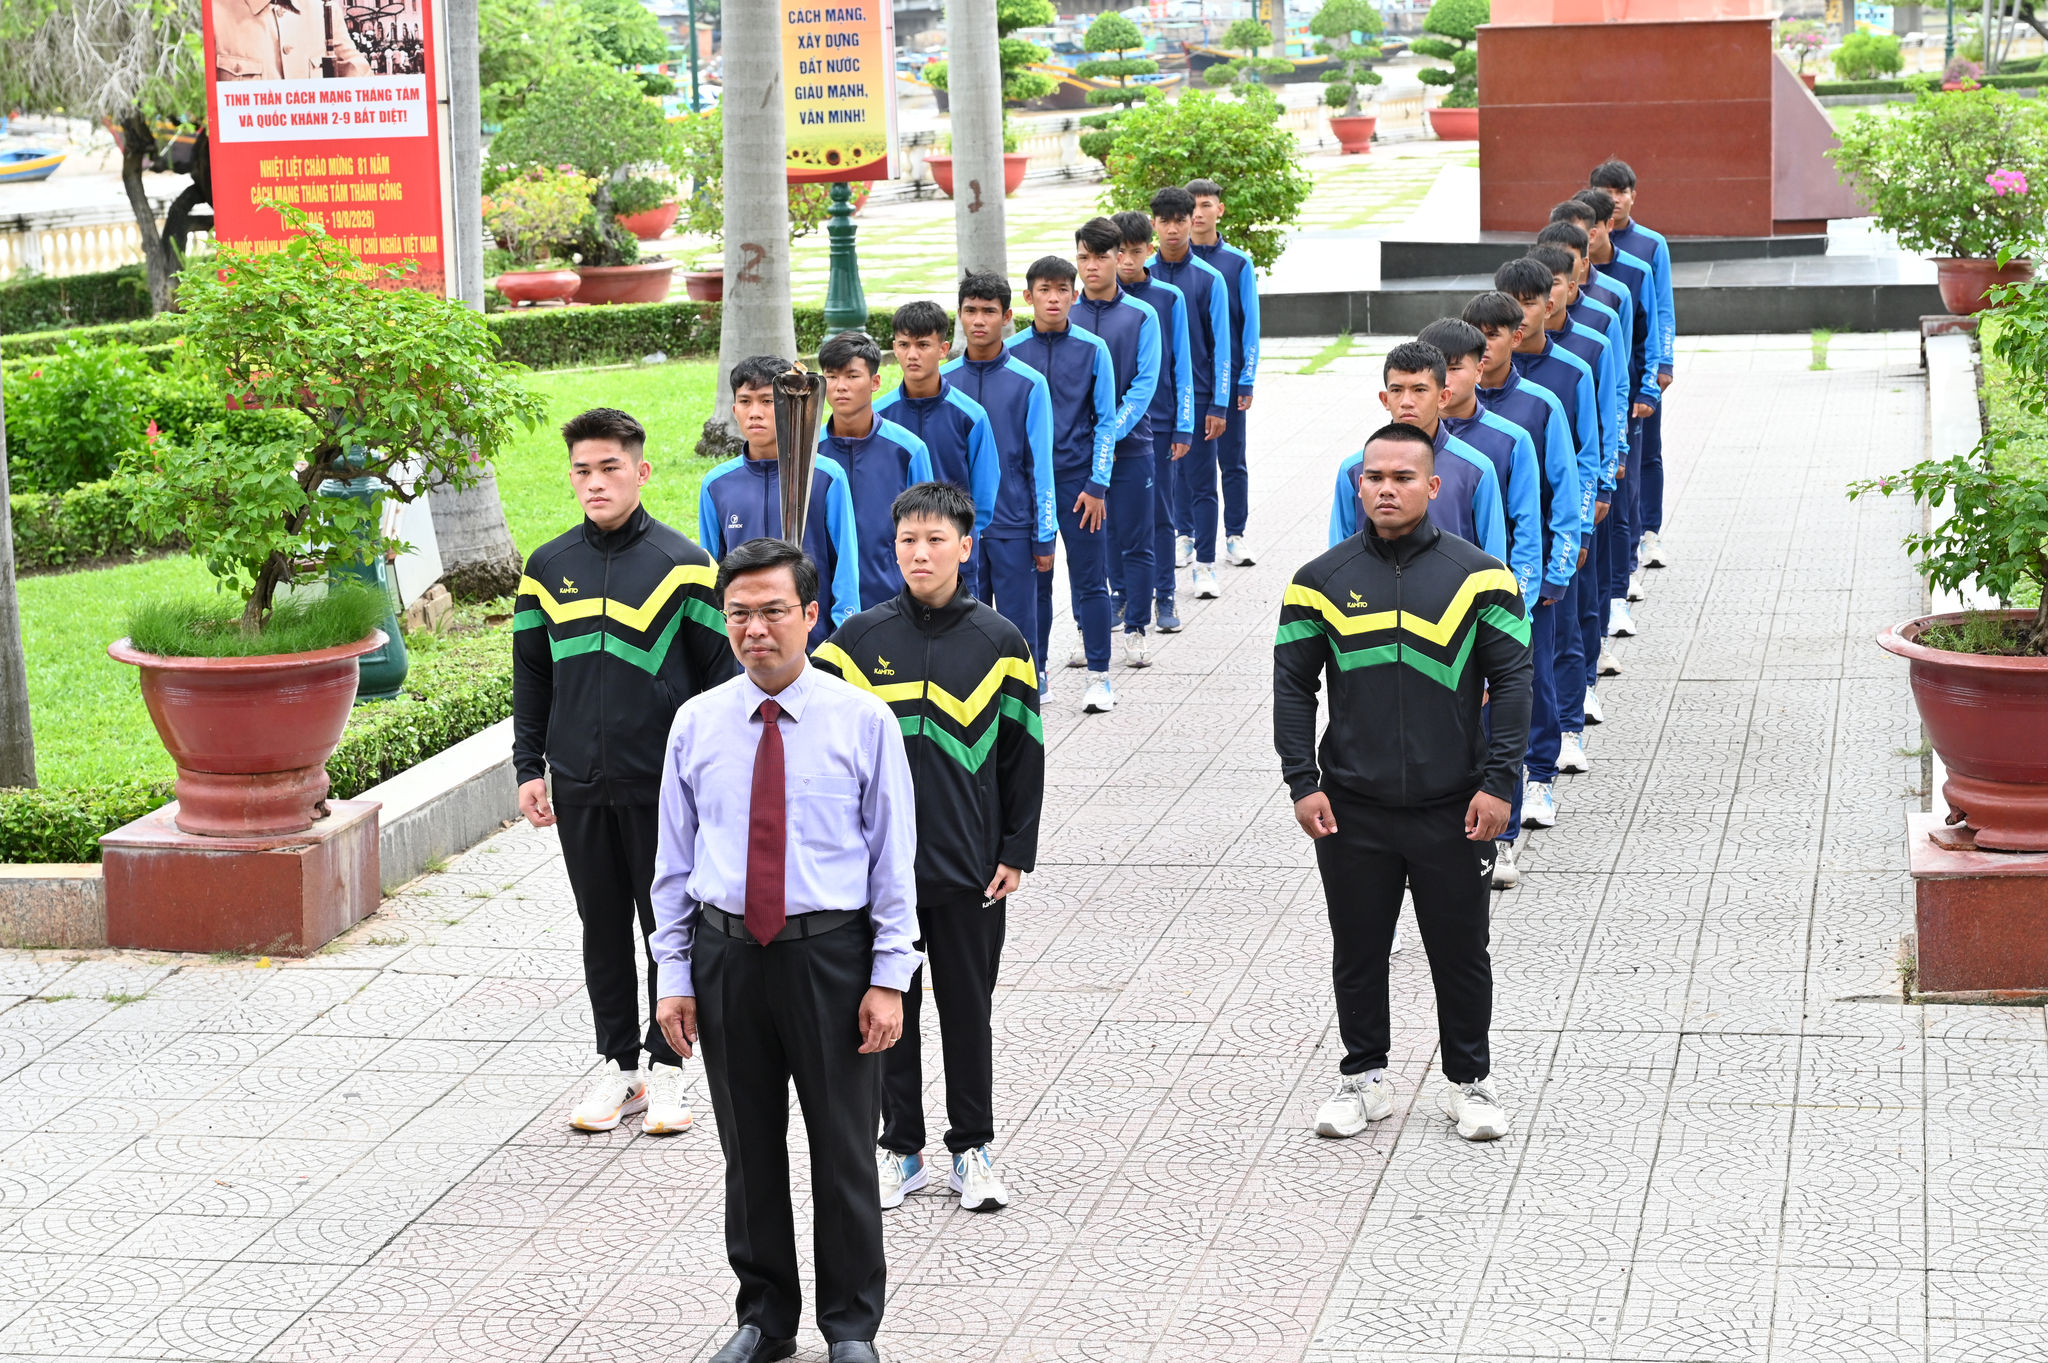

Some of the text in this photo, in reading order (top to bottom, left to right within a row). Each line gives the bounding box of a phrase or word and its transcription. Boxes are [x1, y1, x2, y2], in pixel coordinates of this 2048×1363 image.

[788, 7, 867, 25] CÁCH MẠNG,
[797, 32, 860, 50] XÂY DỰNG
[799, 56, 861, 75] ĐẤT NƯỚC
[224, 85, 420, 106] TINH THẦN CÁCH MẠNG THÁNG TÁM
[794, 83, 869, 101] GIÀU MẠNH,
[239, 106, 408, 128] VÀ QUỐC KHÁNH 2-9 BẤT DIỆT!
[799, 108, 866, 125] VĂN MINH!
[260, 152, 390, 181] NHIỆT LIỆT CHÀO MỪNG 81 NĂM
[301, 181, 329, 203] THÁNG
[330, 180, 349, 202] TÁM
[349, 179, 378, 202] THÀNH
[379, 179, 403, 201] CÔNG
[331, 210, 375, 230] 19/8/2026)
[363, 232, 378, 254] CHỦ
[379, 234, 402, 254] NGHĨA
[402, 233, 419, 257] VIỆT
[419, 236, 438, 253] NAM
[737, 242, 766, 284] 2
[873, 667, 895, 676] KAMITO
